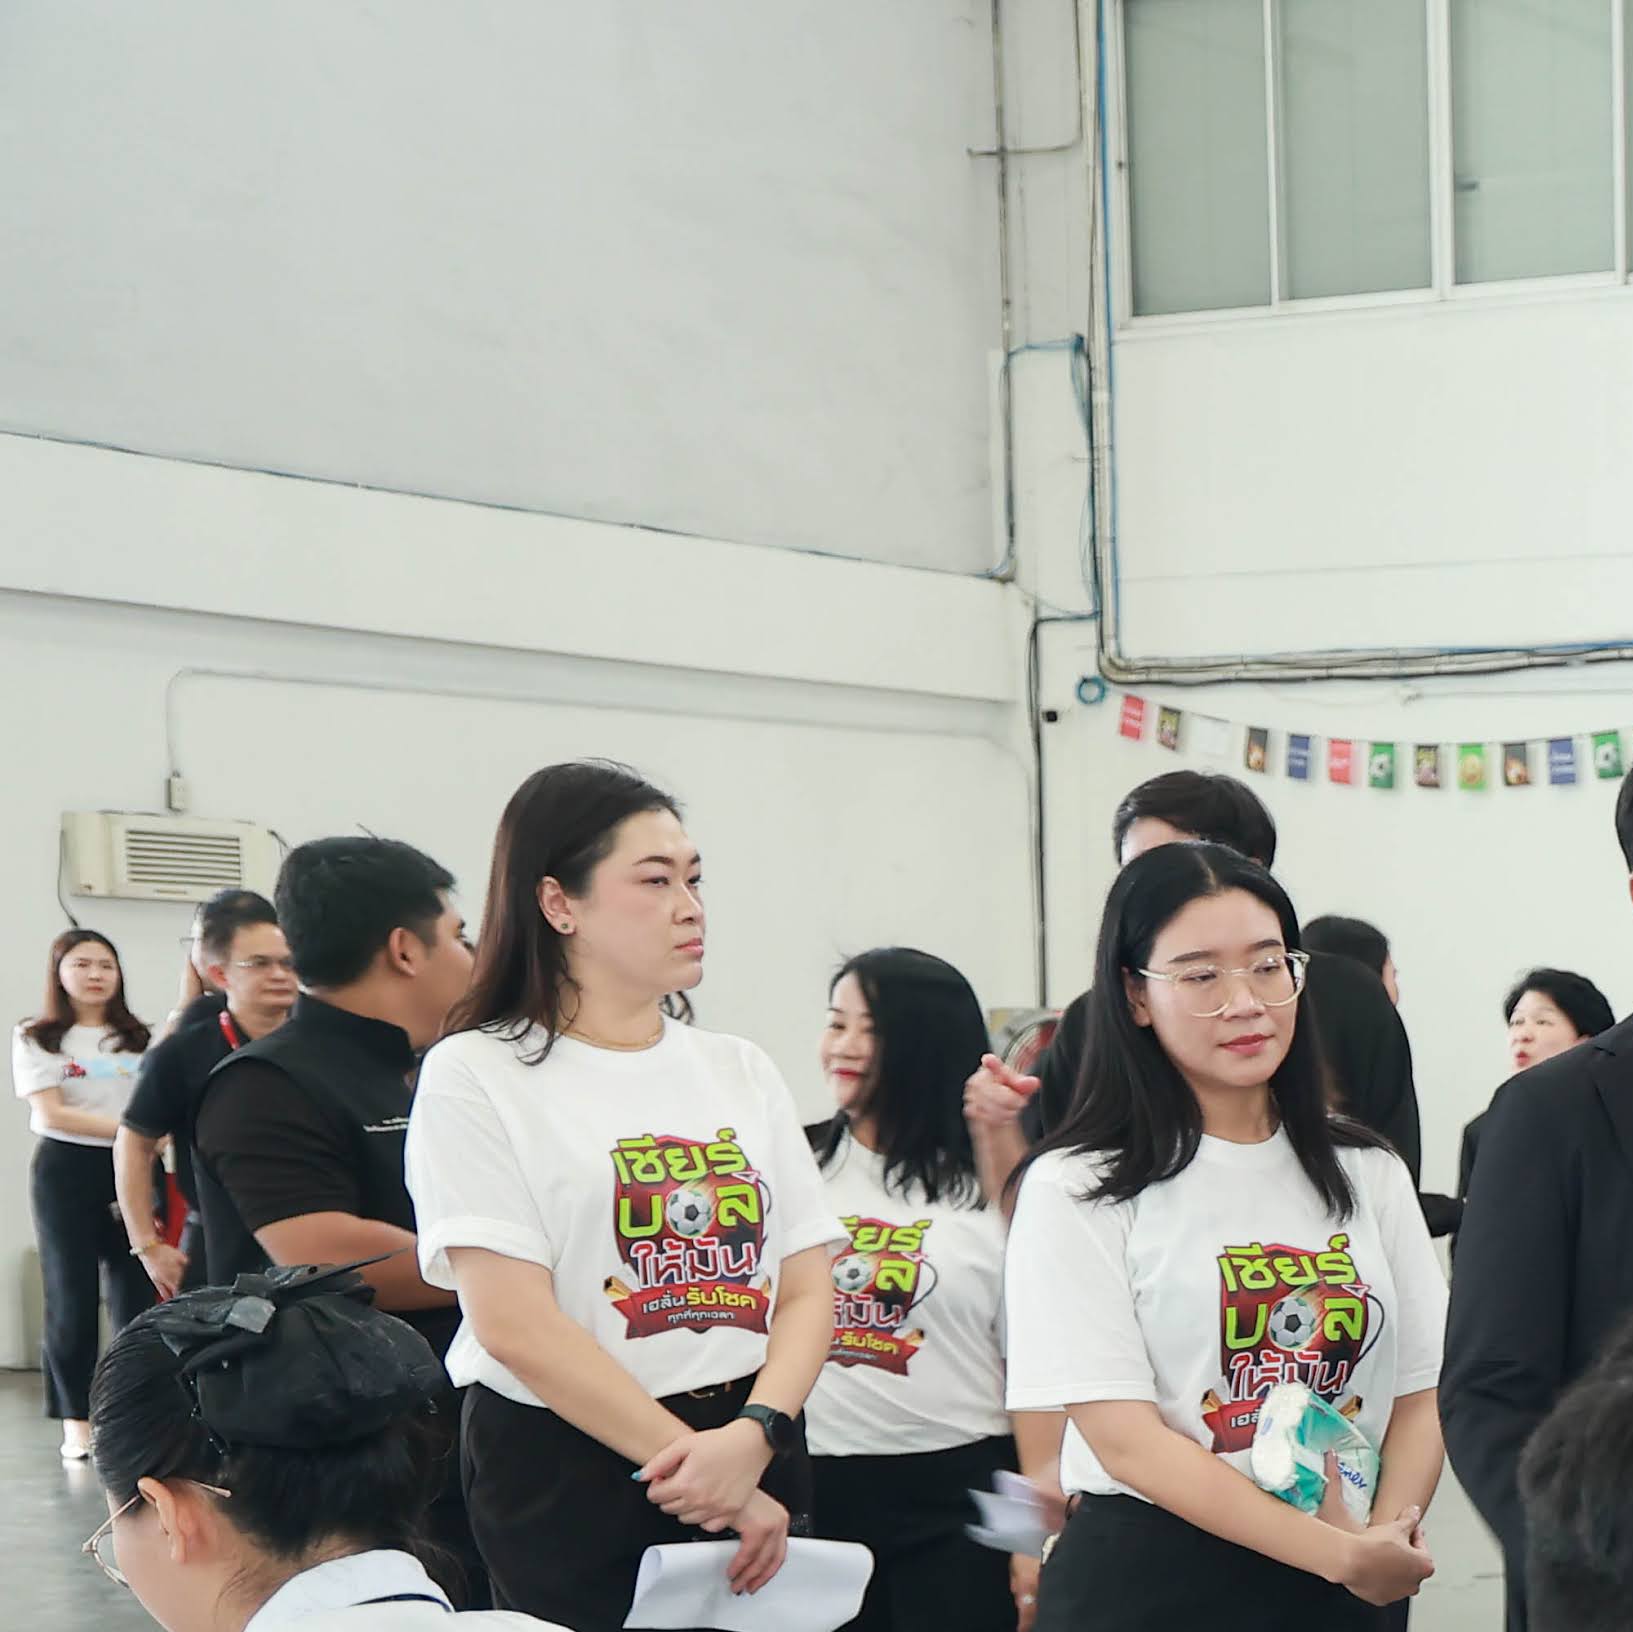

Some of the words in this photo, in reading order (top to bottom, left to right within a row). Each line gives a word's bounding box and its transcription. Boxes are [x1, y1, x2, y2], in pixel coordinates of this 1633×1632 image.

[609, 1127, 748, 1185] เชียร์
[630, 1236, 758, 1289] ให้มัน
[1216, 1233, 1358, 1293] เชียร์
[667, 1309, 736, 1325] ทุกที่ทุกเวลา
